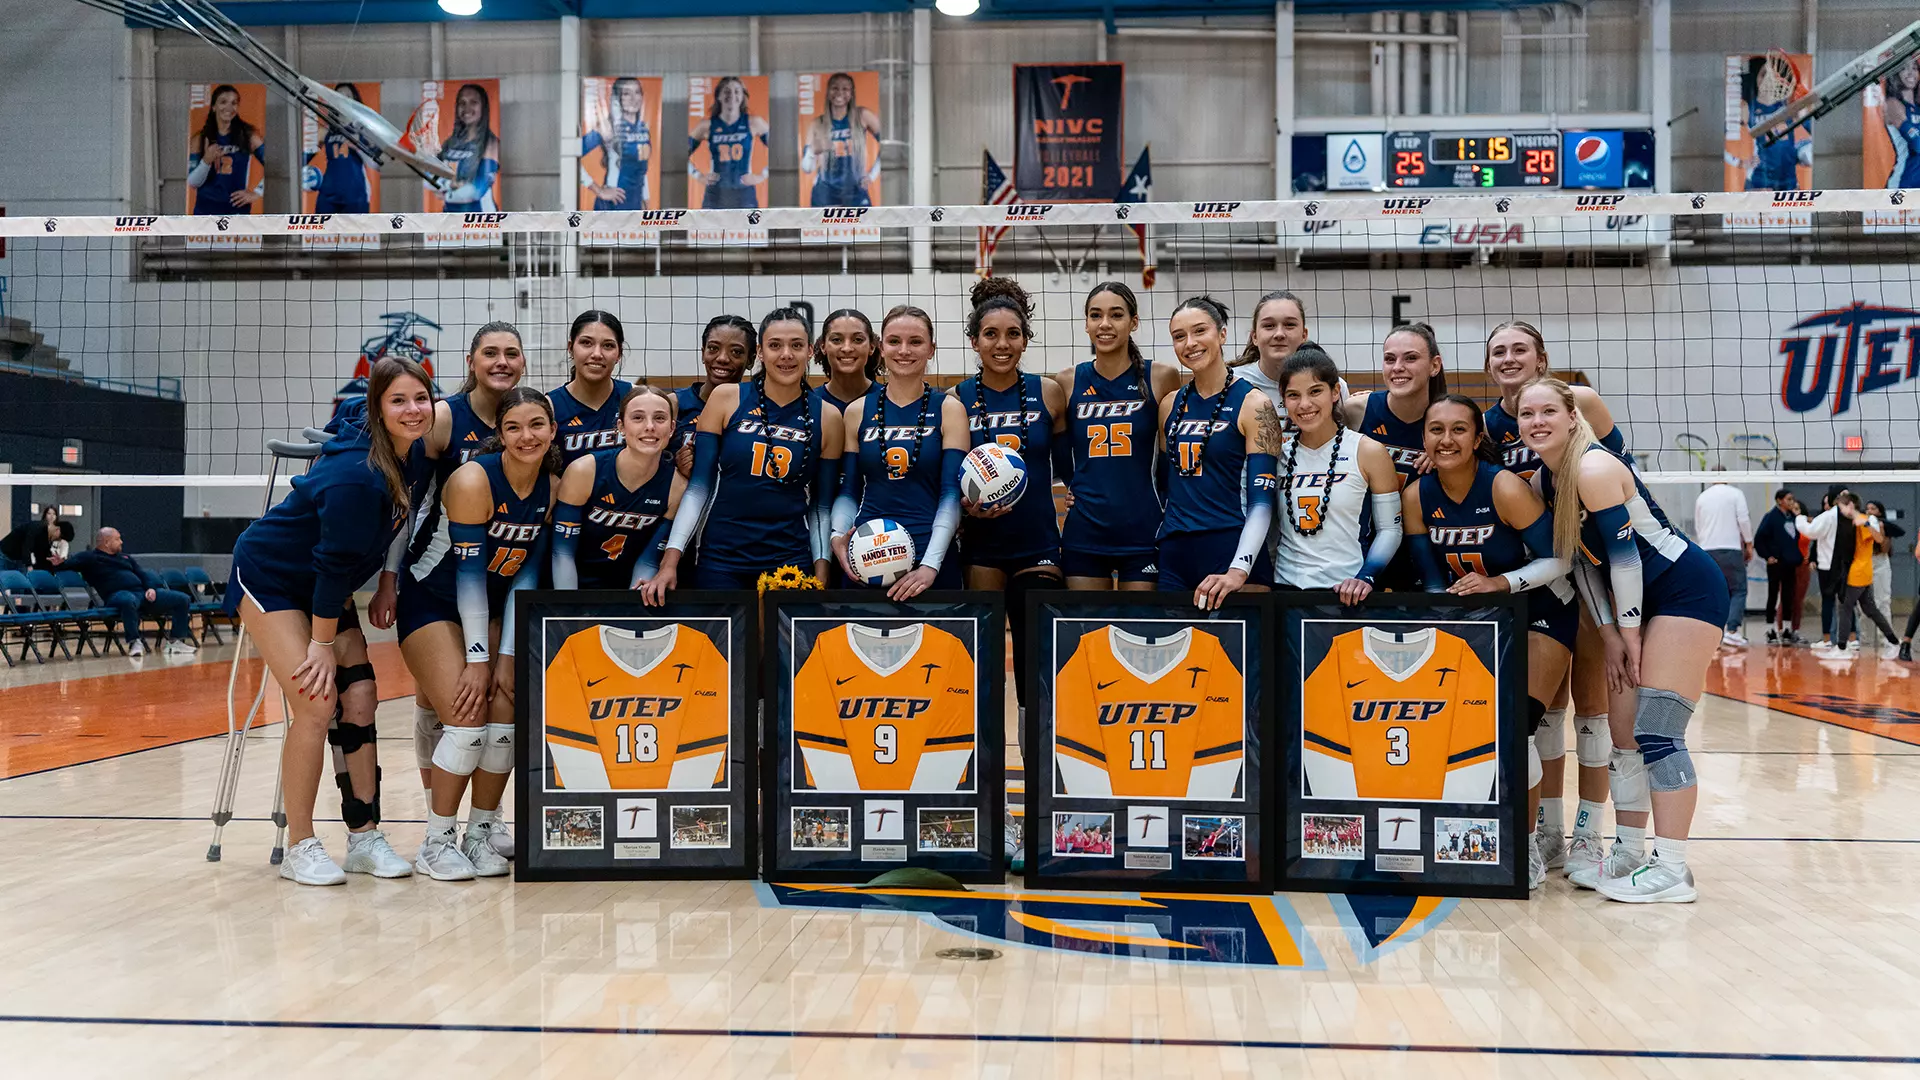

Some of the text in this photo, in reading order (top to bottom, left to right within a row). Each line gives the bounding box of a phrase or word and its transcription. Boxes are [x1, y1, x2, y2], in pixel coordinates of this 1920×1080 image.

[1034, 118, 1104, 134] NIVC
[711, 132, 749, 144] UTEP
[1394, 137, 1421, 149] UTEP
[1515, 136, 1558, 148] VISITOR
[1395, 151, 1425, 175] 25
[1525, 150, 1555, 174] 20
[1043, 166, 1094, 188] 2021
[1481, 167, 1495, 188] 3
[1384, 198, 1432, 209] UTEP
[1577, 195, 1626, 205] UTEP
[1773, 190, 1823, 201] UTEP
[643, 210, 687, 220] UTEP
[823, 207, 868, 218] UTEP
[1007, 205, 1053, 215] UTEP
[1194, 202, 1241, 213] UTEP
[116, 216, 158, 227] UTEP
[289, 214, 332, 225] UTEP
[464, 213, 508, 223] UTEP
[1725, 217, 1809, 226] VOLLEYBALL
[188, 235, 261, 244] VOLLEYBALL
[304, 235, 379, 244] VOLLEYBALL
[425, 232, 501, 242] VOLLEYBALL
[583, 231, 656, 240] VOLLEYBALL
[690, 231, 768, 240] VOLLEYBALL
[803, 228, 878, 237] VOLLEYBALL
[1076, 399, 1147, 420] UTEP
[969, 410, 1041, 432] UTEP
[738, 418, 813, 442] UTEP
[863, 425, 936, 443] UTEP
[1087, 422, 1132, 458] 25
[751, 441, 793, 479] 18
[886, 446, 910, 480] 9
[1178, 442, 1203, 477] 11
[987, 474, 1021, 501] molten
[1253, 477, 1276, 489] 915
[587, 506, 659, 530] UTEP
[1298, 496, 1321, 531] 3
[555, 524, 581, 536] 915
[1428, 524, 1495, 546] UTEP
[600, 533, 628, 561] 4
[873, 533, 891, 547] UTEP
[453, 546, 480, 557] 915
[861, 549, 887, 562] HANDE
[888, 545, 907, 556] YETIS
[487, 546, 527, 577] 12
[946, 687, 969, 695] C-USA
[1205, 695, 1229, 703] C-USA
[588, 696, 683, 720] UTEP
[838, 696, 932, 720] UTEP
[1097, 701, 1198, 726] UTEP
[1351, 698, 1448, 722] UTEP
[615, 723, 658, 763] 18
[874, 724, 898, 764] 9
[1129, 729, 1168, 770] 11
[1385, 726, 1409, 766] 3
